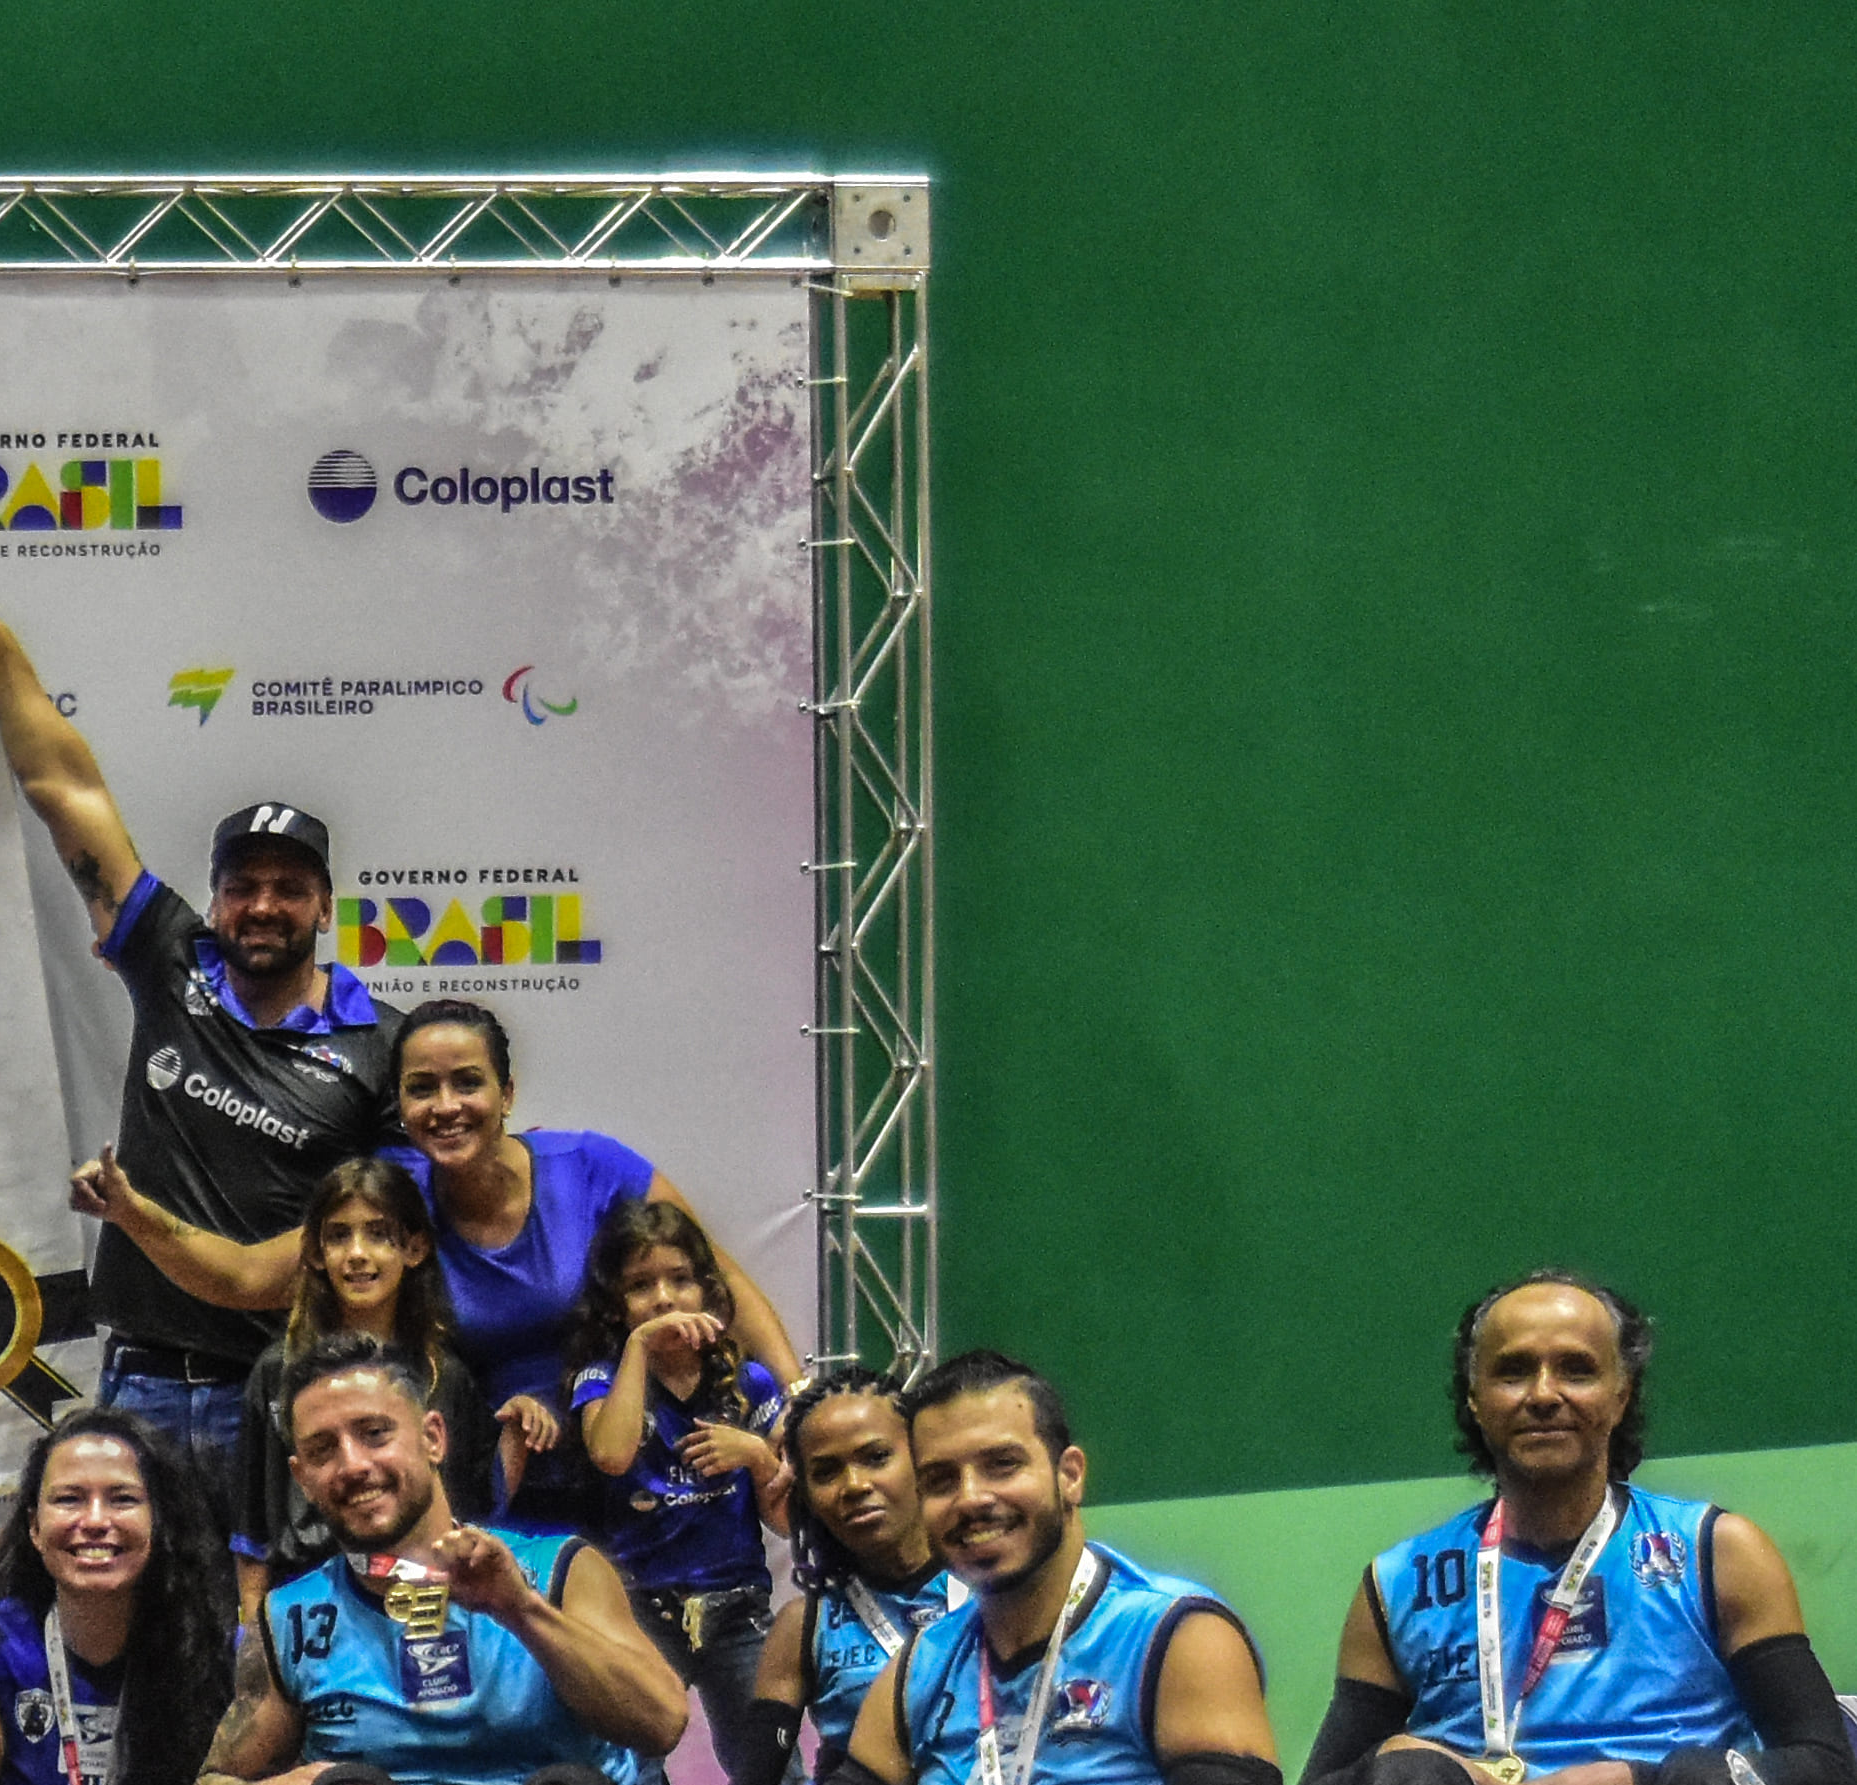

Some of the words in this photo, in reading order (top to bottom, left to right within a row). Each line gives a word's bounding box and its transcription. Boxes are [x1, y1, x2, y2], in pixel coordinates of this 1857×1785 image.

[57, 433, 159, 448] FEDERAL
[393, 467, 614, 513] Coloplast
[0, 545, 9, 557] E
[17, 542, 161, 559] RECONSTRUÇÃO
[252, 677, 333, 697] COMITÊ
[252, 700, 374, 716] BRASILEIRO
[358, 870, 468, 885] GOVERNO
[479, 868, 580, 883] FEDERAL
[336, 894, 602, 967] BRASIL
[423, 980, 431, 992] E
[439, 976, 580, 993] RECONSTRUÇÃO
[184, 1073, 310, 1150] Coloplast
[1412, 1548, 1466, 1613] 10
[287, 1603, 338, 1664] 13
